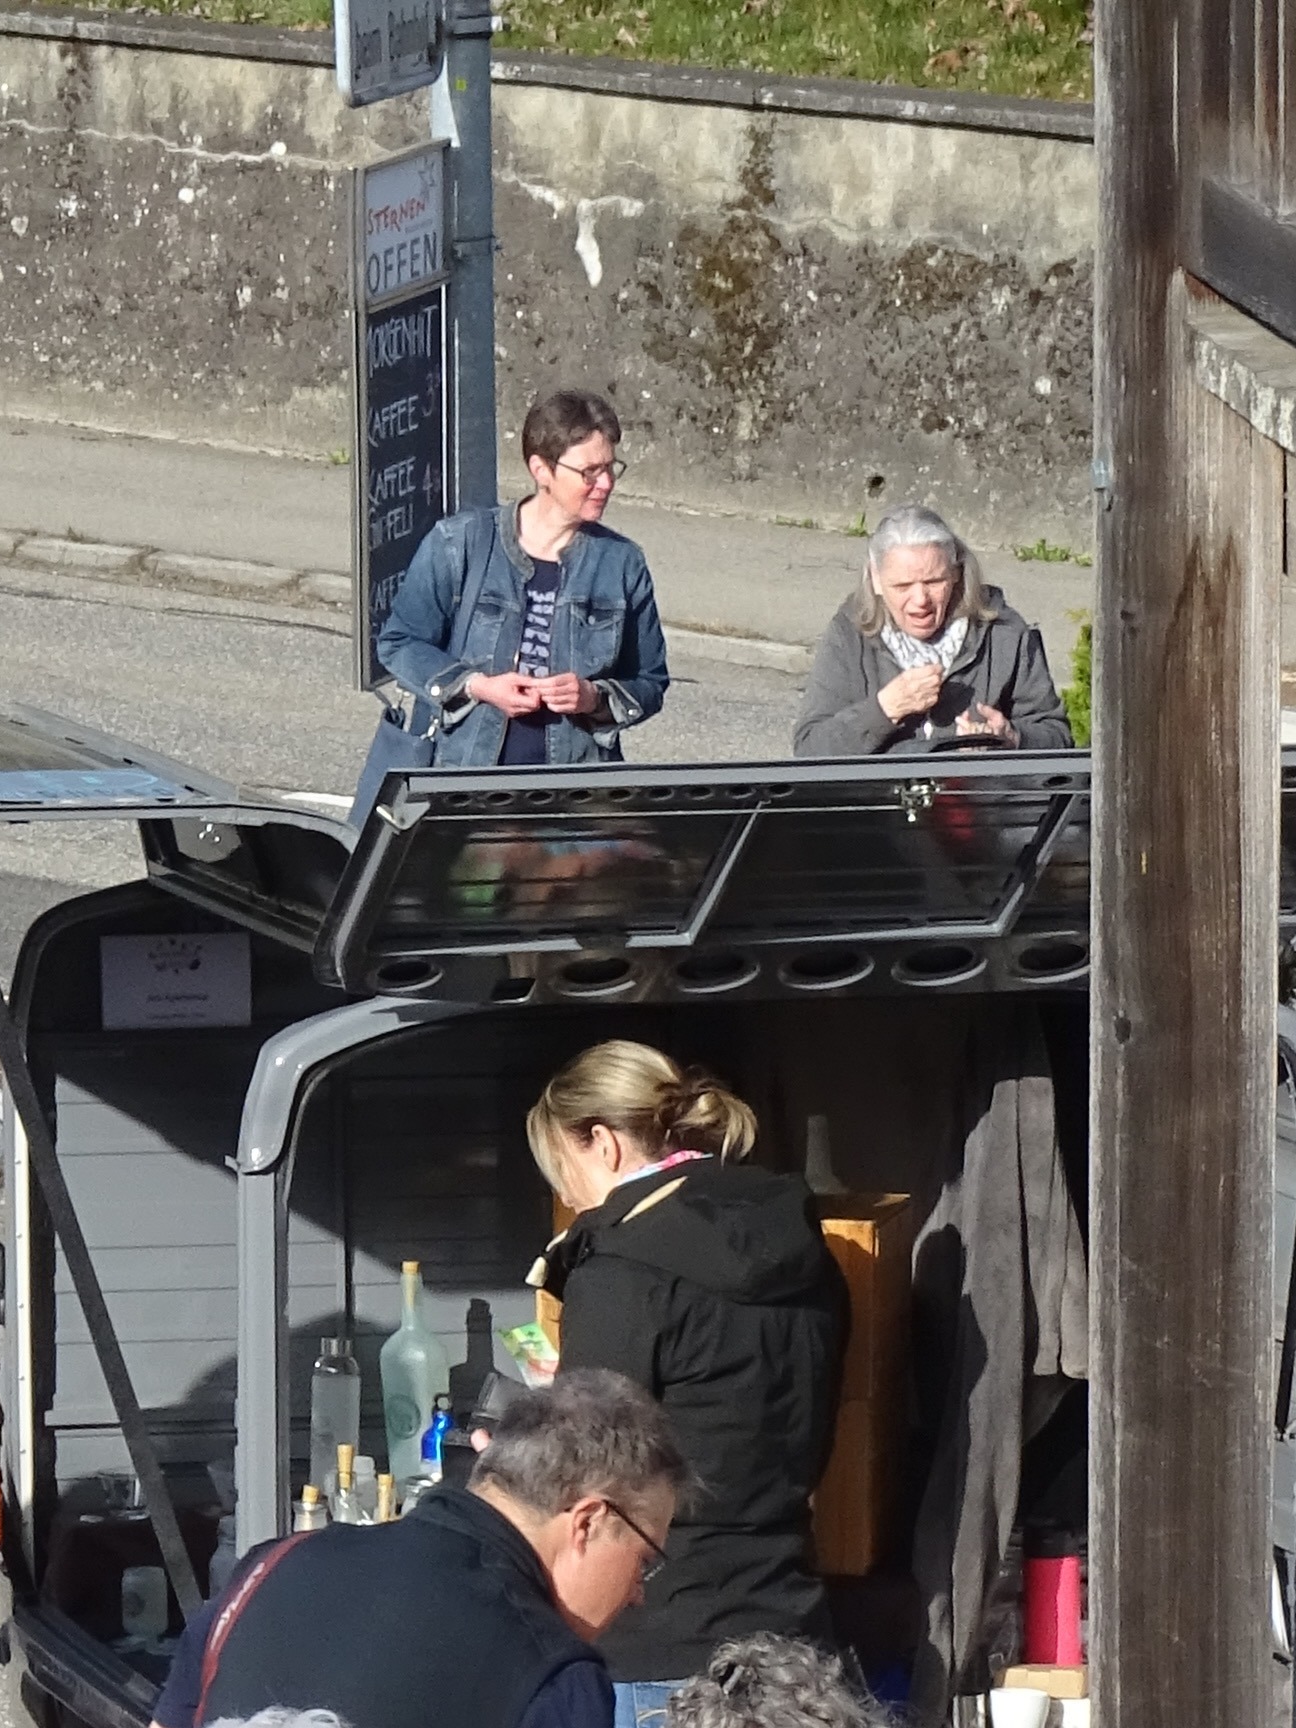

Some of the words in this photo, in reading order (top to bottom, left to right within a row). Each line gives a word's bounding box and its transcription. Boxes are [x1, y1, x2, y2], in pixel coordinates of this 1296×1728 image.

[368, 197, 427, 236] STERNEN
[367, 232, 437, 294] OFFEN
[368, 395, 420, 447] KAFFEE
[368, 456, 417, 506] KAFFEE
